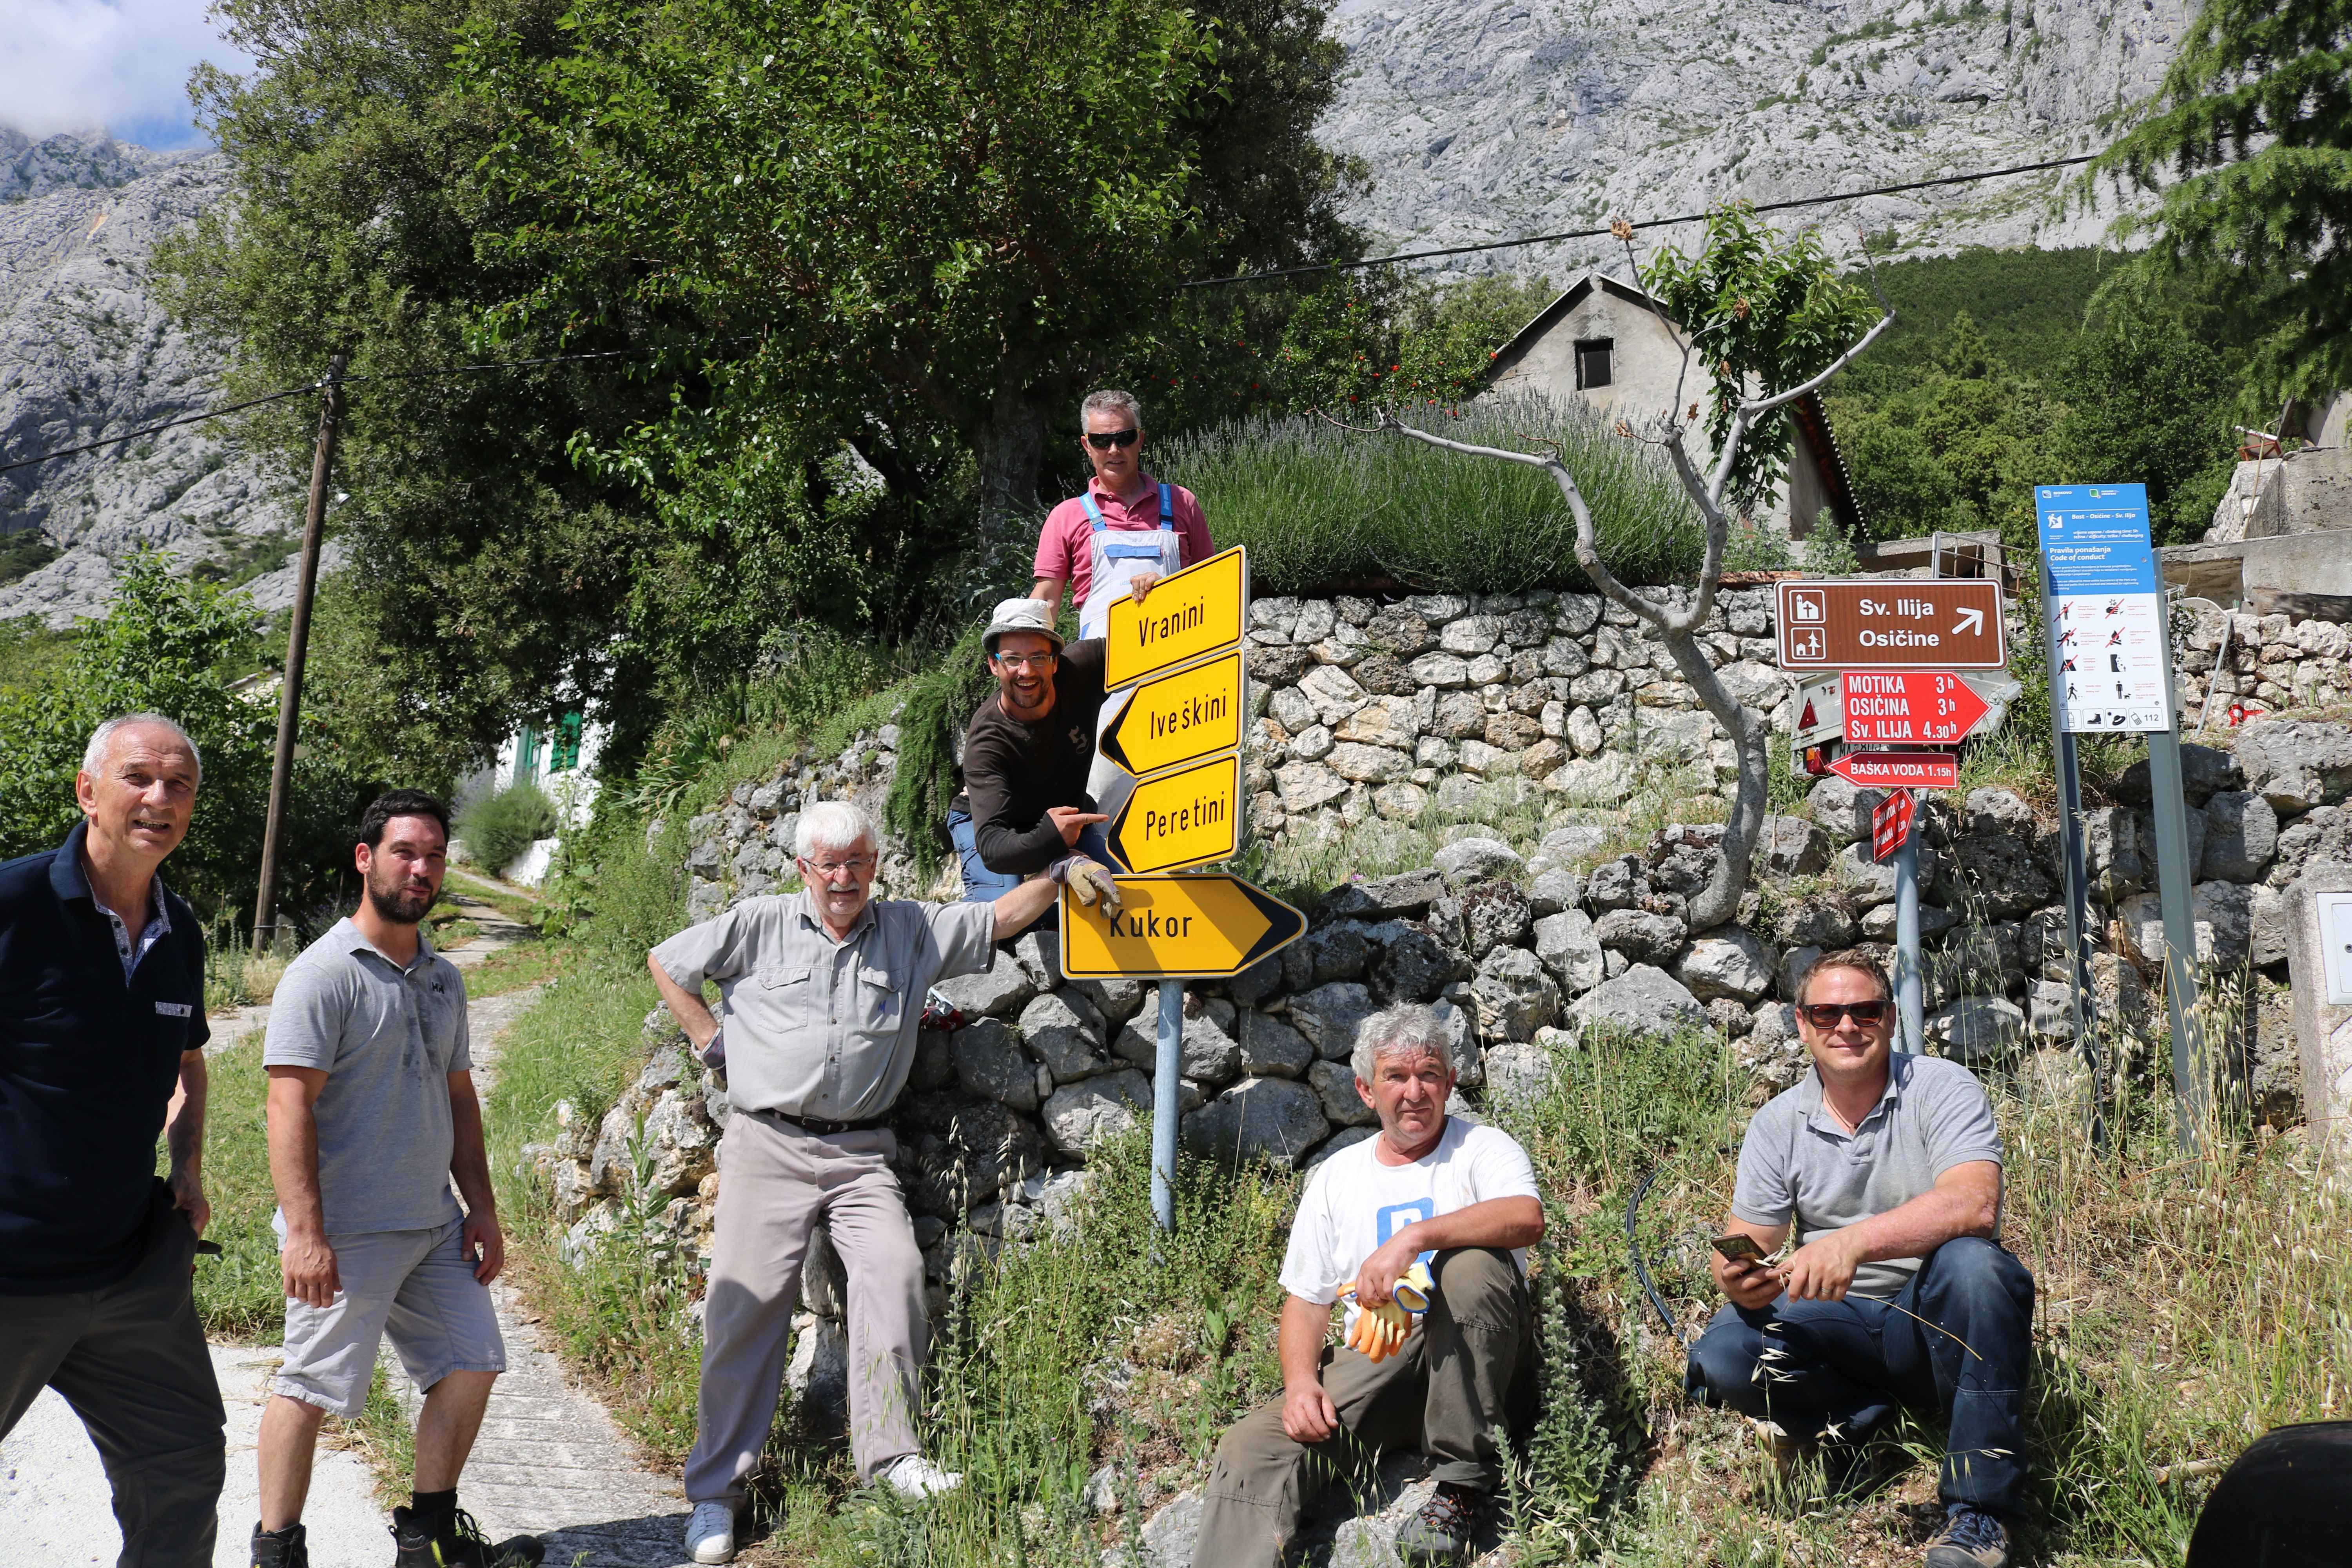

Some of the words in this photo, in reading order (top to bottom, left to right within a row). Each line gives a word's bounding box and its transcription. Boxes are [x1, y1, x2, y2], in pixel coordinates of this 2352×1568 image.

[2075, 546, 2111, 554] ponašanja
[1859, 599, 1891, 616] Sv.
[1897, 599, 1934, 620] Ilija
[1139, 595, 1203, 647] Vranini
[1859, 630, 1940, 647] Osičine
[1848, 675, 1906, 693] MOTIKA
[1151, 688, 1226, 740] Iveškini
[1850, 694, 1910, 716] OSIČINA
[1851, 720, 1871, 739] Sv.
[1876, 720, 1913, 739] ILIJA
[1850, 760, 1890, 775] BAŠKA
[1891, 764, 1925, 776] VODA
[1927, 765, 1952, 777] 1.15h
[1146, 791, 1224, 841] Peretini
[1886, 803, 1896, 821] VODA
[1110, 909, 1192, 937] Kukor
[432, 981, 445, 994] HH
